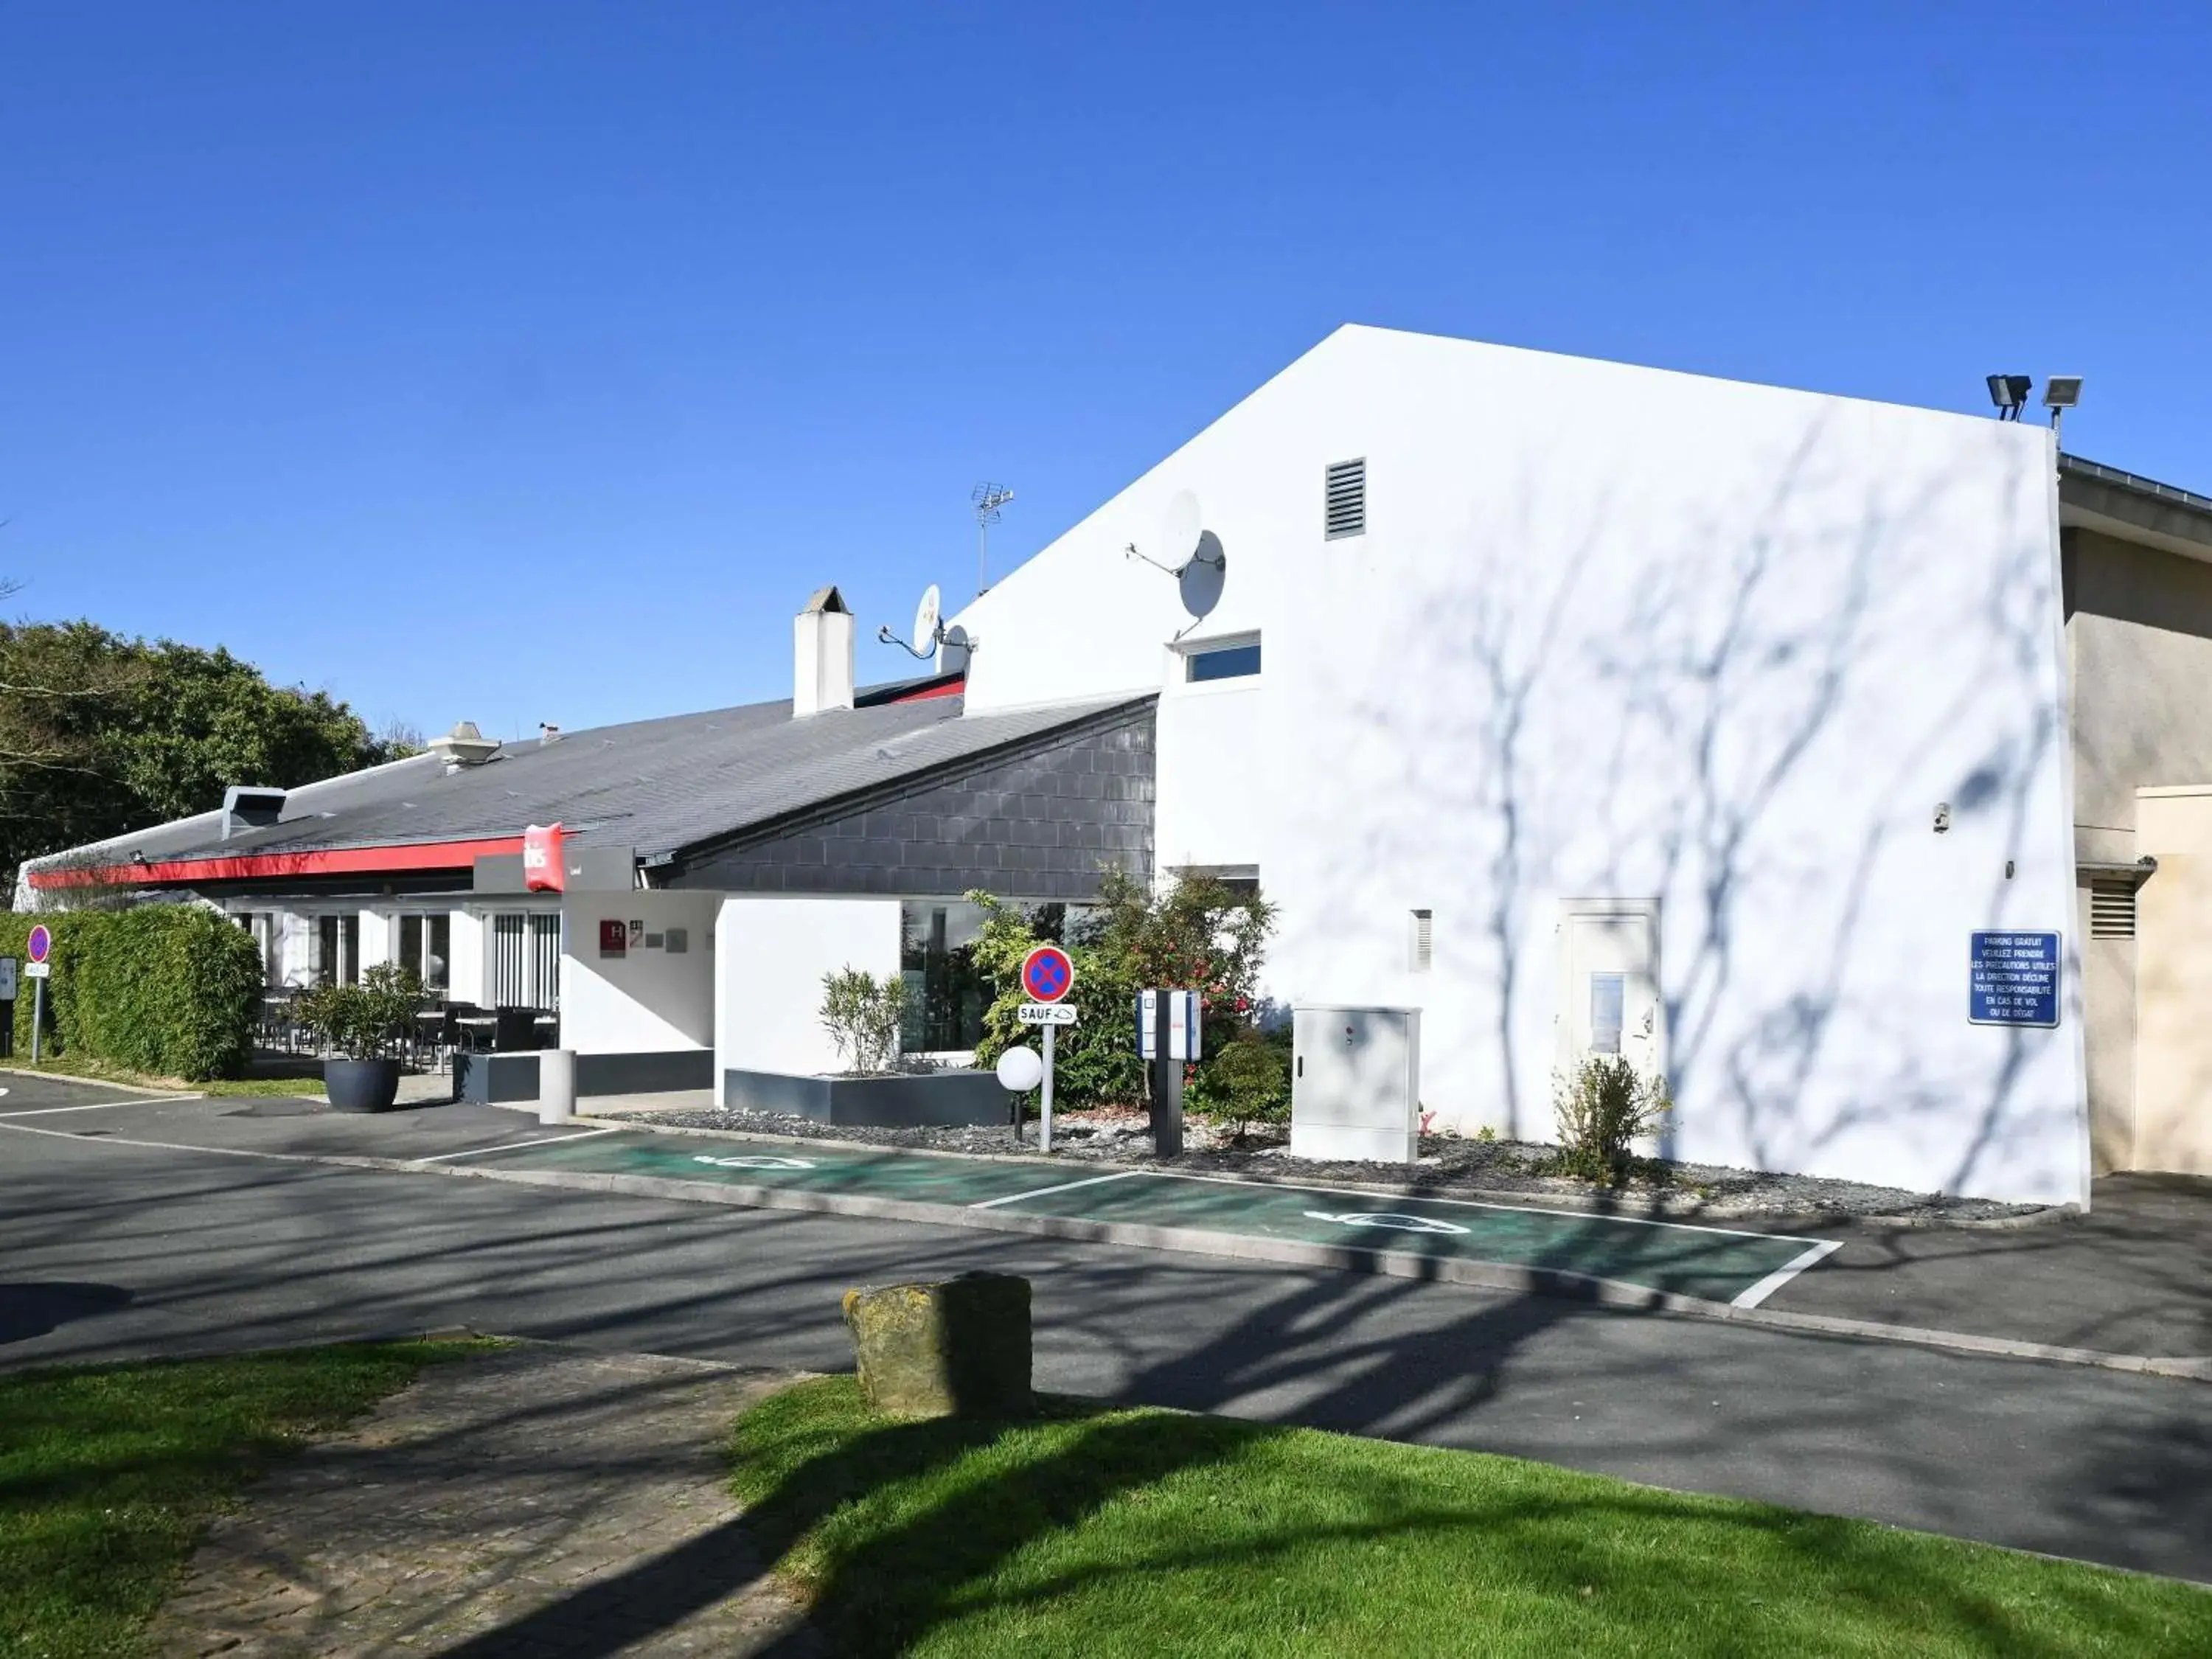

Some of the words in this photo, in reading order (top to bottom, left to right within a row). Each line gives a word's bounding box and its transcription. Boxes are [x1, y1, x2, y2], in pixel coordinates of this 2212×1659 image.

[611, 925, 623, 938] H
[2014, 938, 2042, 946] GRATUIT
[1972, 961, 1983, 969] LES
[1020, 1008, 1052, 1020] SAUF
